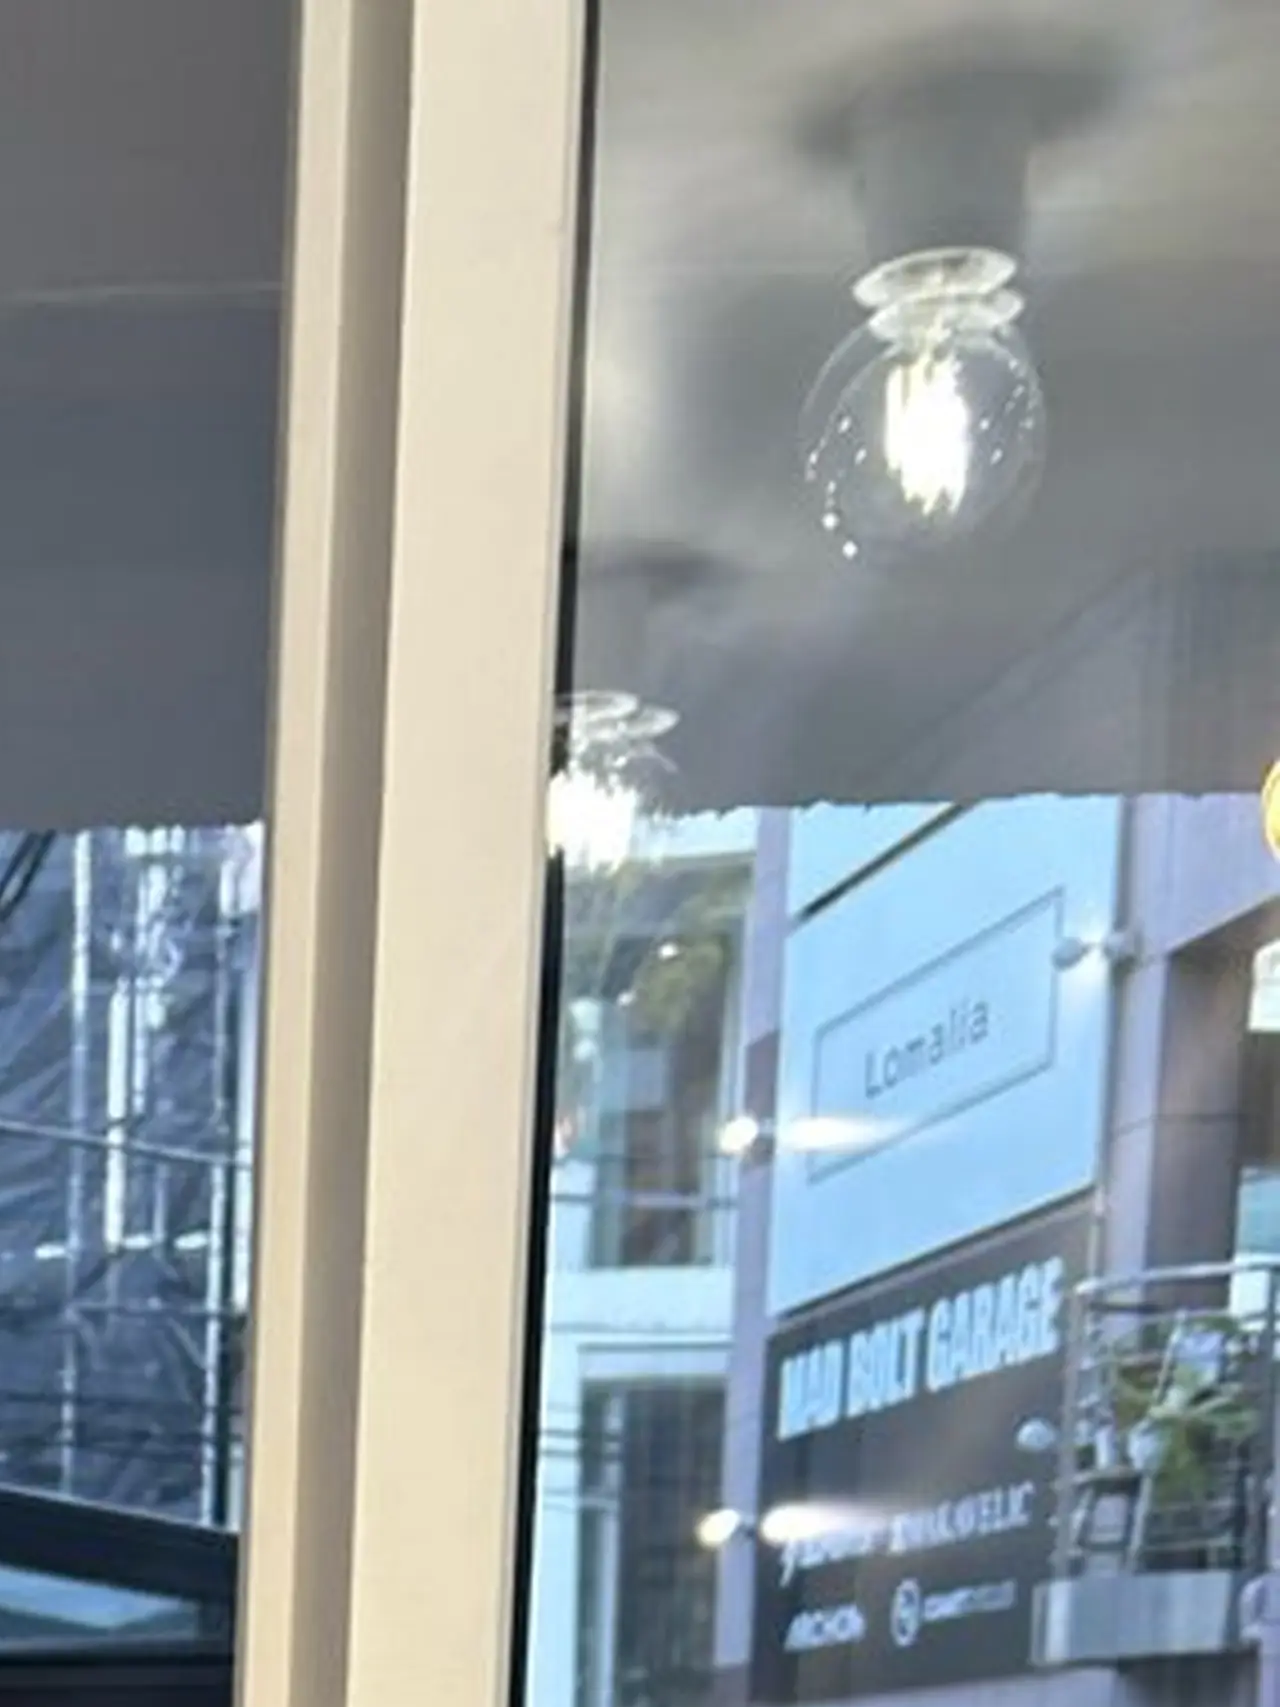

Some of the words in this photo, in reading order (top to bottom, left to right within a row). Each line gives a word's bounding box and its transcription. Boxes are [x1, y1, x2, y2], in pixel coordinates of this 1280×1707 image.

[864, 1000, 990, 1100] Lomalia
[847, 1307, 926, 1420] BOLT
[925, 1256, 1064, 1393] GARAGE
